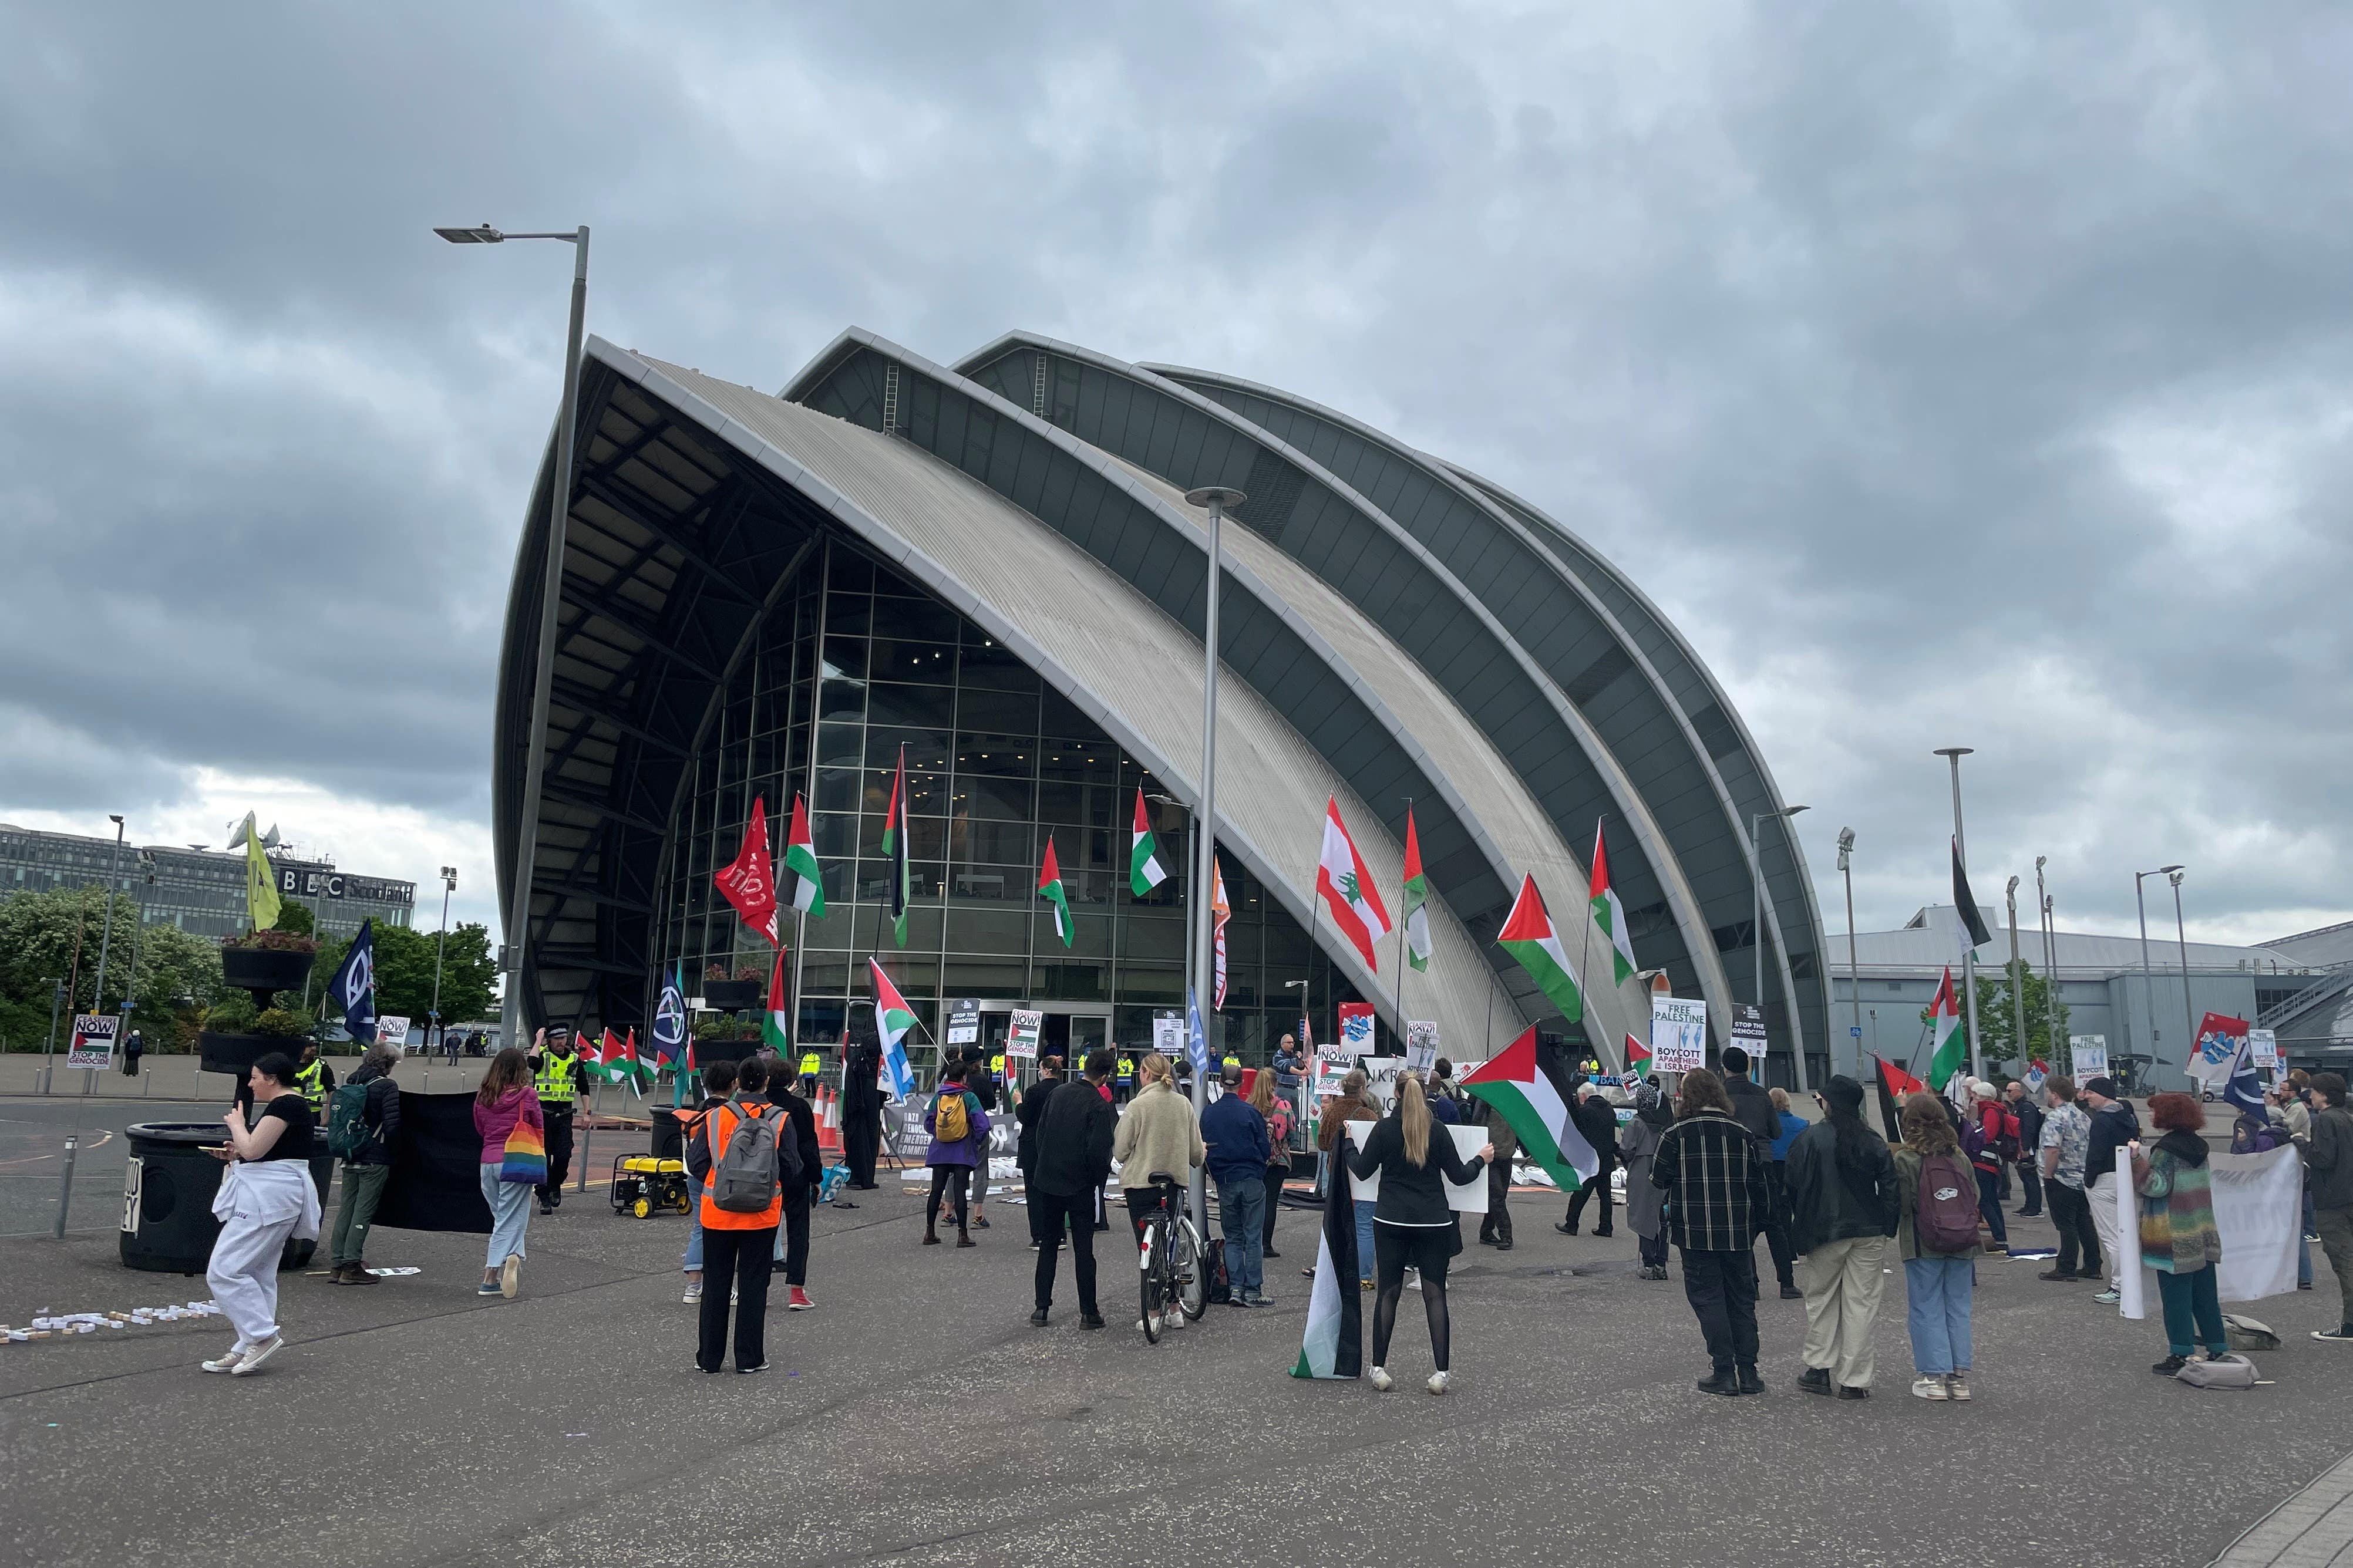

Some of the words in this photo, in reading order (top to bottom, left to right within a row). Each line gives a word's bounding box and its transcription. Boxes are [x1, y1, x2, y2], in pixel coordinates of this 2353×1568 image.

[350, 879, 413, 902] Scotland
[1669, 1005, 1691, 1014] FREE
[1012, 1014, 1041, 1026] NOW!
[1655, 1011, 1705, 1023] PALESTINE
[76, 1021, 116, 1033] NOW!
[380, 1021, 408, 1032] NOW!
[1732, 1027, 1766, 1036] GENOCIDE
[1008, 1046, 1036, 1054] GENOCIDE
[1658, 1047, 1701, 1058] BOYCOTT
[1658, 1056, 1699, 1065] APARTHEID
